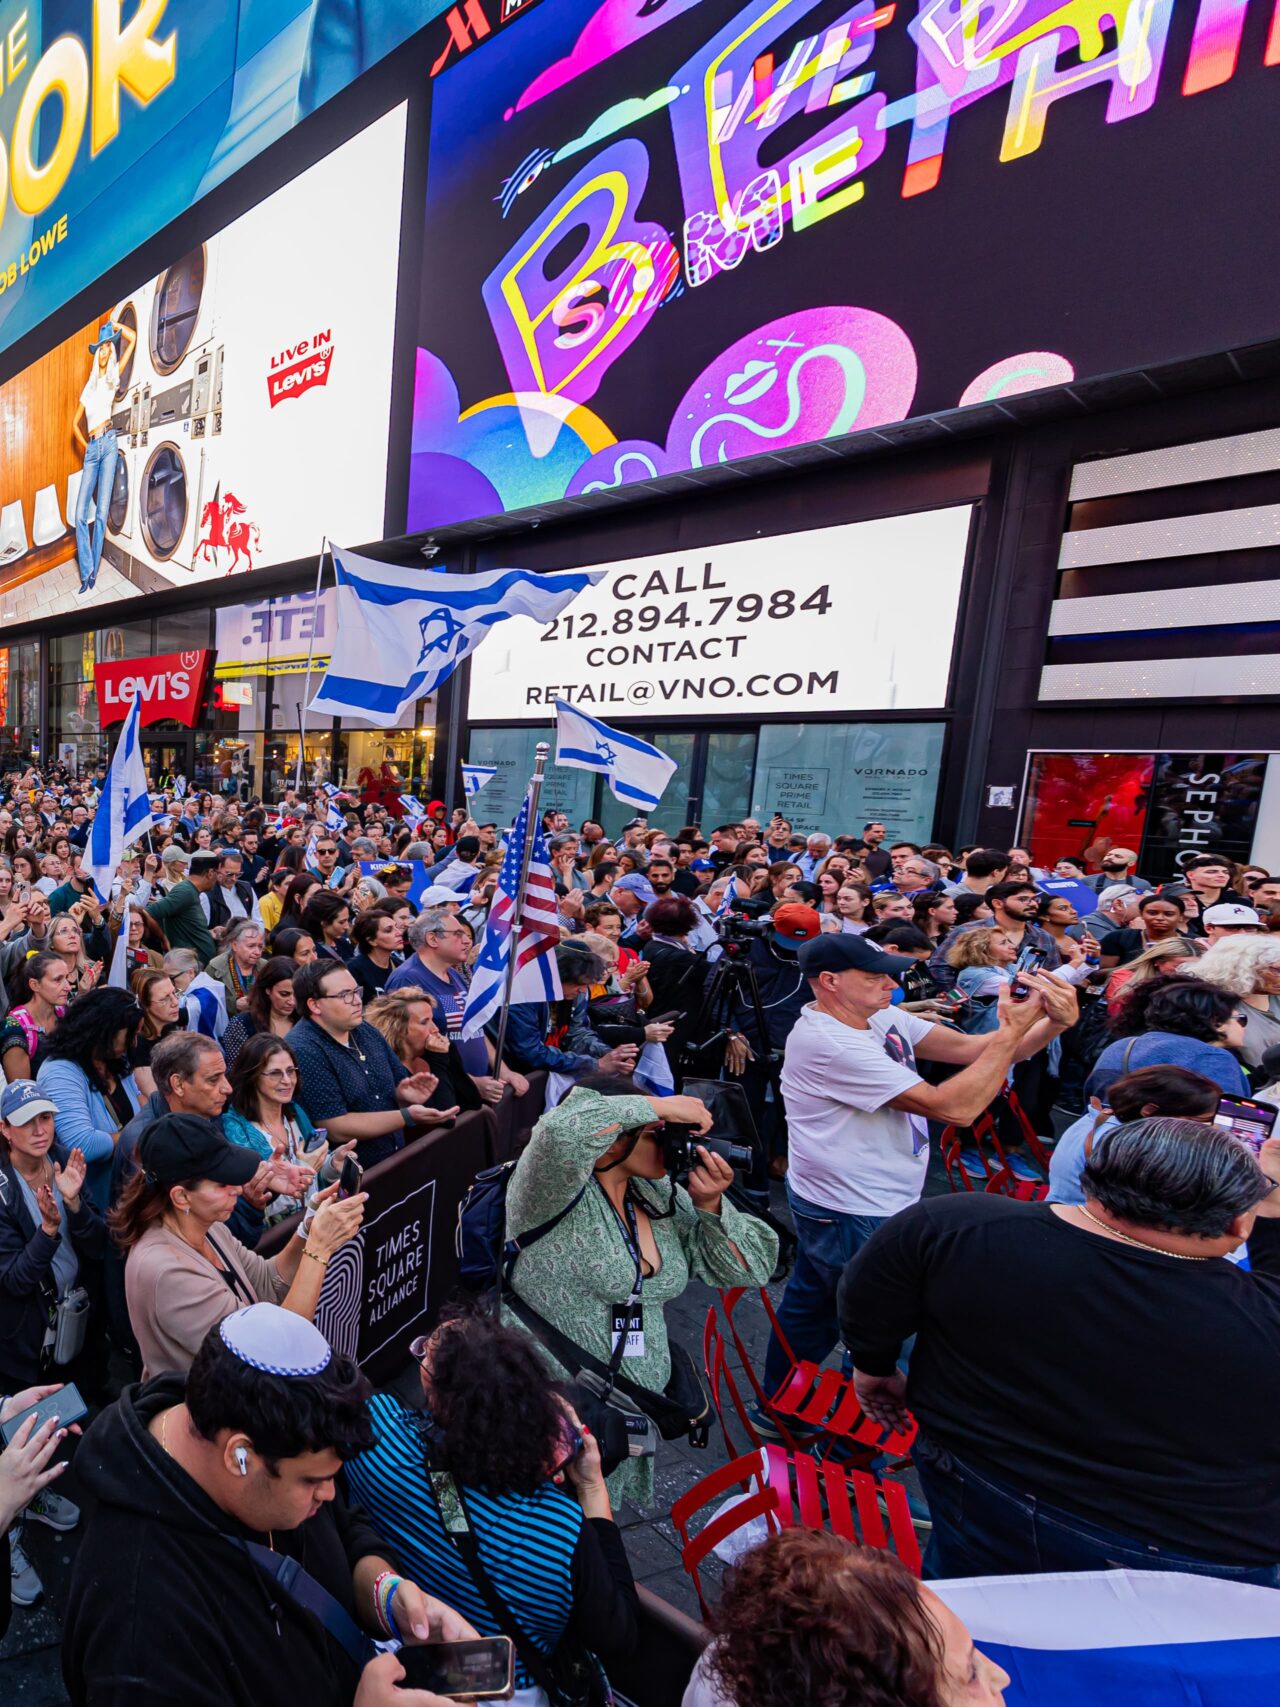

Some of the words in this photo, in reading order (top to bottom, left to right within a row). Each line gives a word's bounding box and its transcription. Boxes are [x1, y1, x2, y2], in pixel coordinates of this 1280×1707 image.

[20, 213, 68, 276] LOWE
[313, 328, 331, 349] IN
[612, 562, 726, 600] CALL
[540, 584, 833, 642] 212.894.7984
[586, 634, 747, 667] CONTACT
[525, 670, 839, 706] RETAIL@VNO.COM
[775, 782, 819, 790] SQUARE
[783, 773, 814, 781] TIMES
[854, 768, 928, 777] VORNADO
[777, 801, 812, 809] RETAIL
[780, 791, 811, 800] PRIME
[376, 1220, 420, 1268] TIMES
[368, 1244, 424, 1303] SQUARE
[369, 1274, 419, 1327] ALLIANCE
